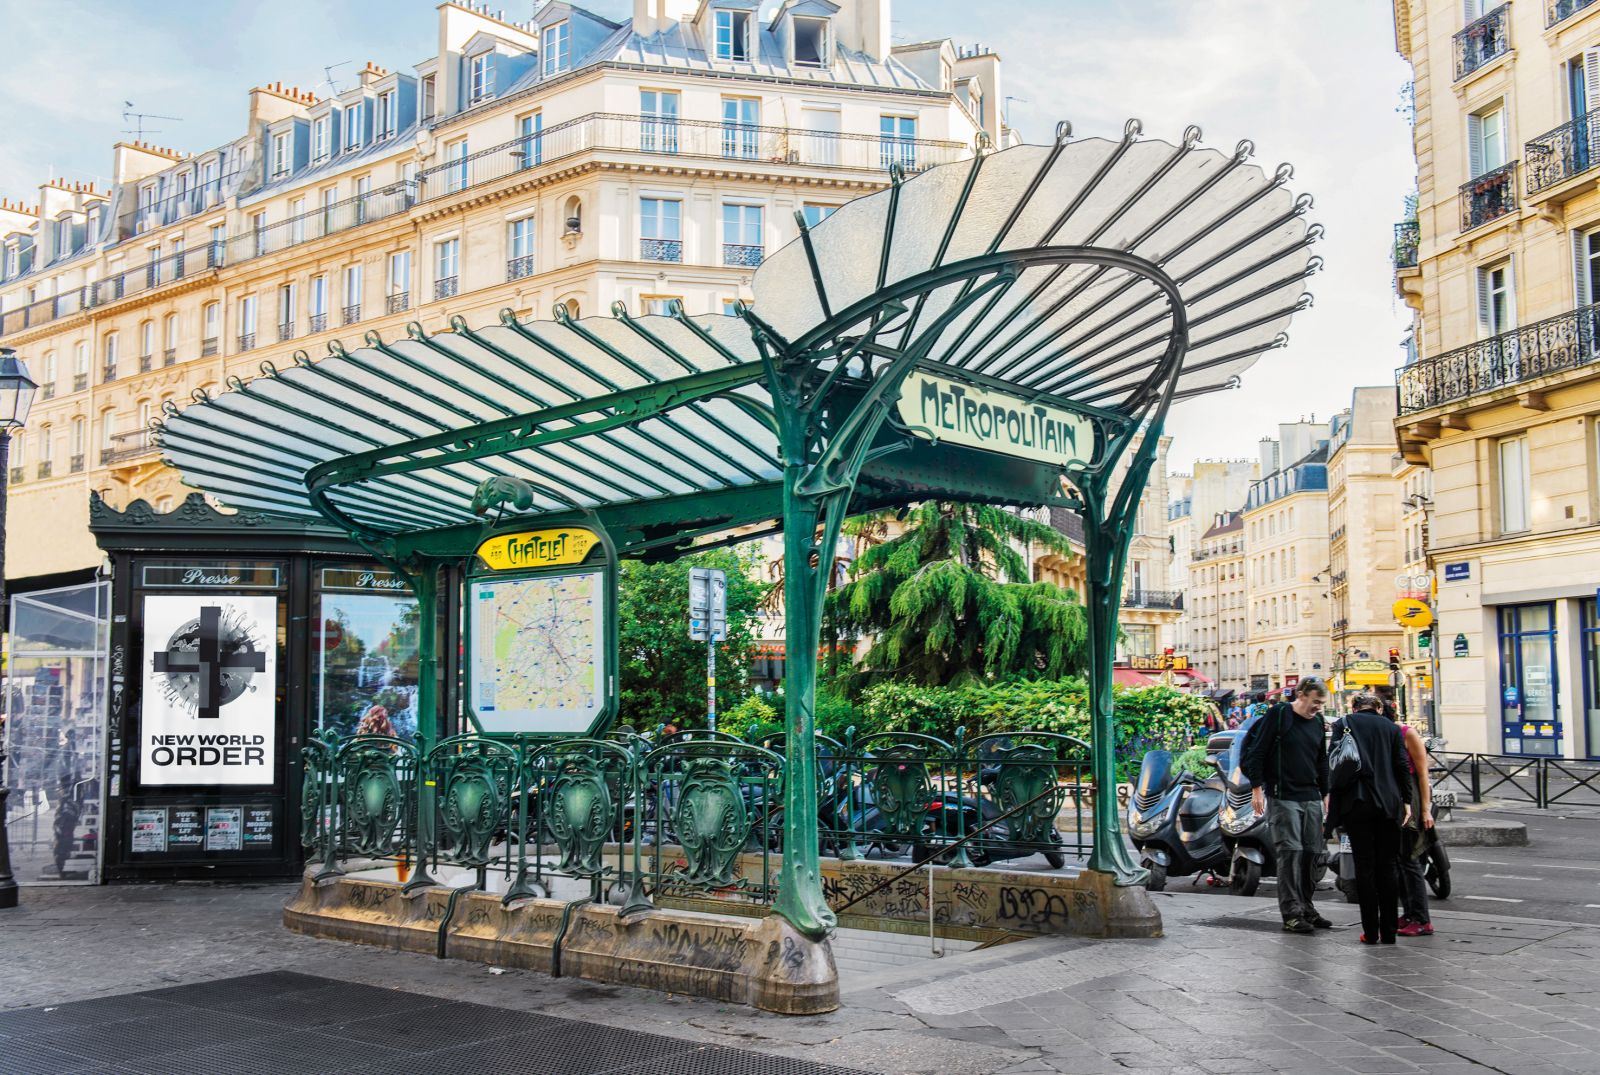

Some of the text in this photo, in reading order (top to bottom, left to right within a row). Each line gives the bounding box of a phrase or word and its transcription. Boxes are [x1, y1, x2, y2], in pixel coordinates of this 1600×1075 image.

[921, 378, 1076, 457] METROPOLITAIN
[181, 568, 240, 585] Presse
[355, 572, 406, 589] Presse
[151, 735, 265, 746] NEW WORLD
[151, 747, 265, 766] ORDER
